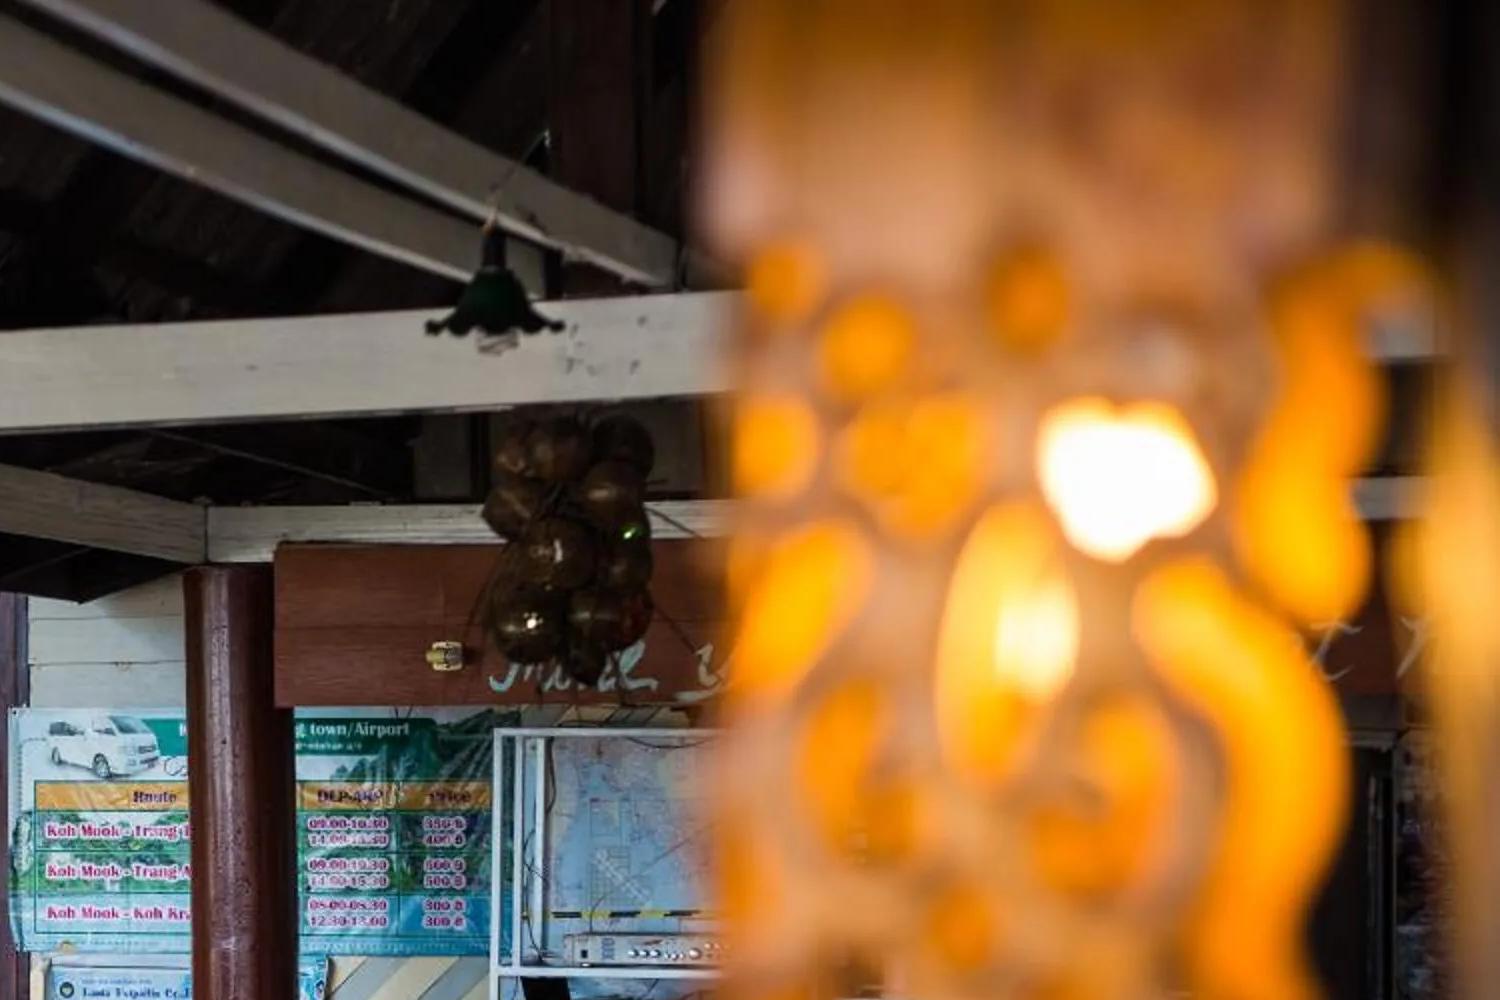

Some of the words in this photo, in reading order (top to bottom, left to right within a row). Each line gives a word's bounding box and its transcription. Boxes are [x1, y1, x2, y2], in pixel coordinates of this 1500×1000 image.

[309, 721, 410, 738] town/Airport
[132, 790, 177, 803] Route
[46, 824, 75, 837] Koh
[81, 824, 119, 837] Mook
[134, 825, 178, 840] Trang
[46, 865, 75, 877] Koh
[81, 865, 119, 877] Mook
[134, 865, 178, 879] Trang
[46, 906, 75, 919] Koh
[81, 906, 119, 919] Mook
[133, 907, 163, 919] Koh
[168, 907, 192, 919] Kra
